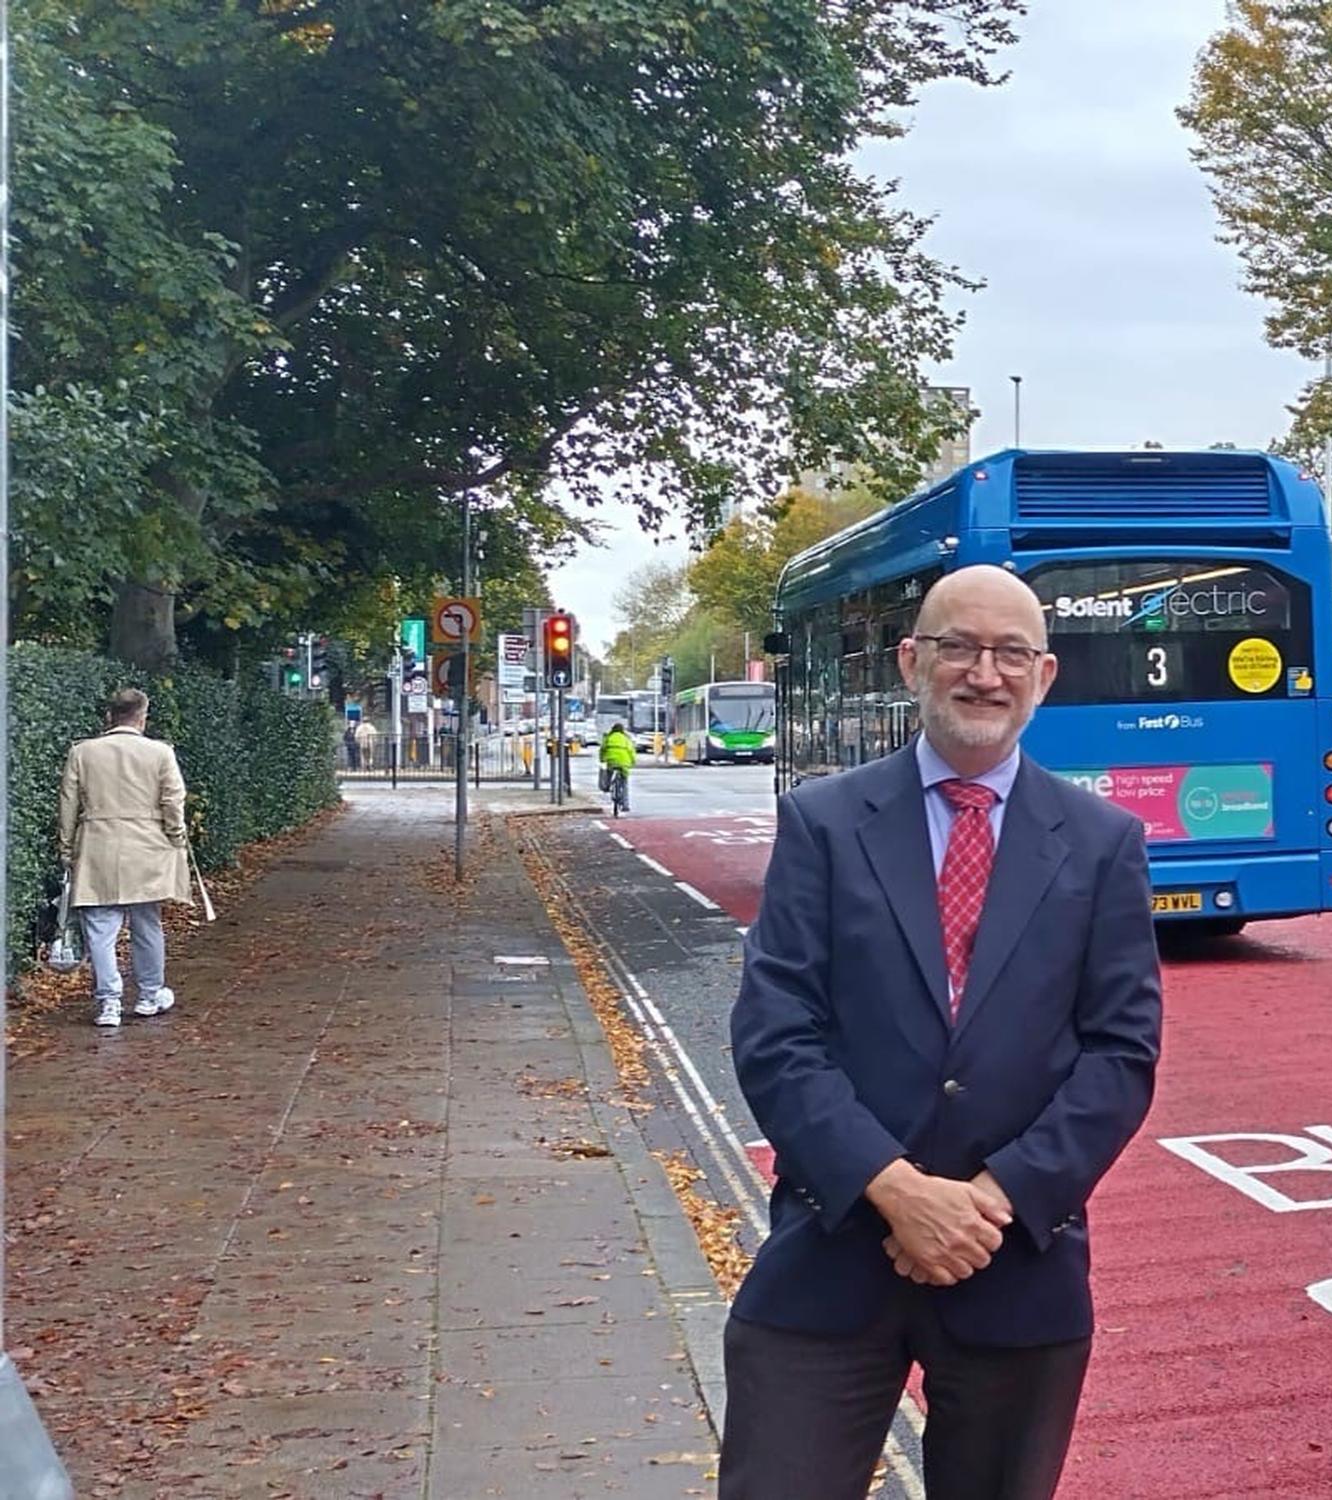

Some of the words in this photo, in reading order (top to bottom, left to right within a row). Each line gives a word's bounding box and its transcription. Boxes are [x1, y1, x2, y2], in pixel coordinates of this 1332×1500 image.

[1056, 596, 1133, 618] Solent
[1140, 582, 1267, 616] electric
[1146, 647, 1168, 687] 3
[1138, 716, 1164, 729] First
[1180, 715, 1204, 728] Bus
[1065, 773, 1114, 797] ne
[1115, 774, 1140, 787] high
[1141, 773, 1174, 785] speed
[1116, 787, 1137, 798] low
[1137, 787, 1167, 799] price
[1171, 895, 1200, 910] WVL
